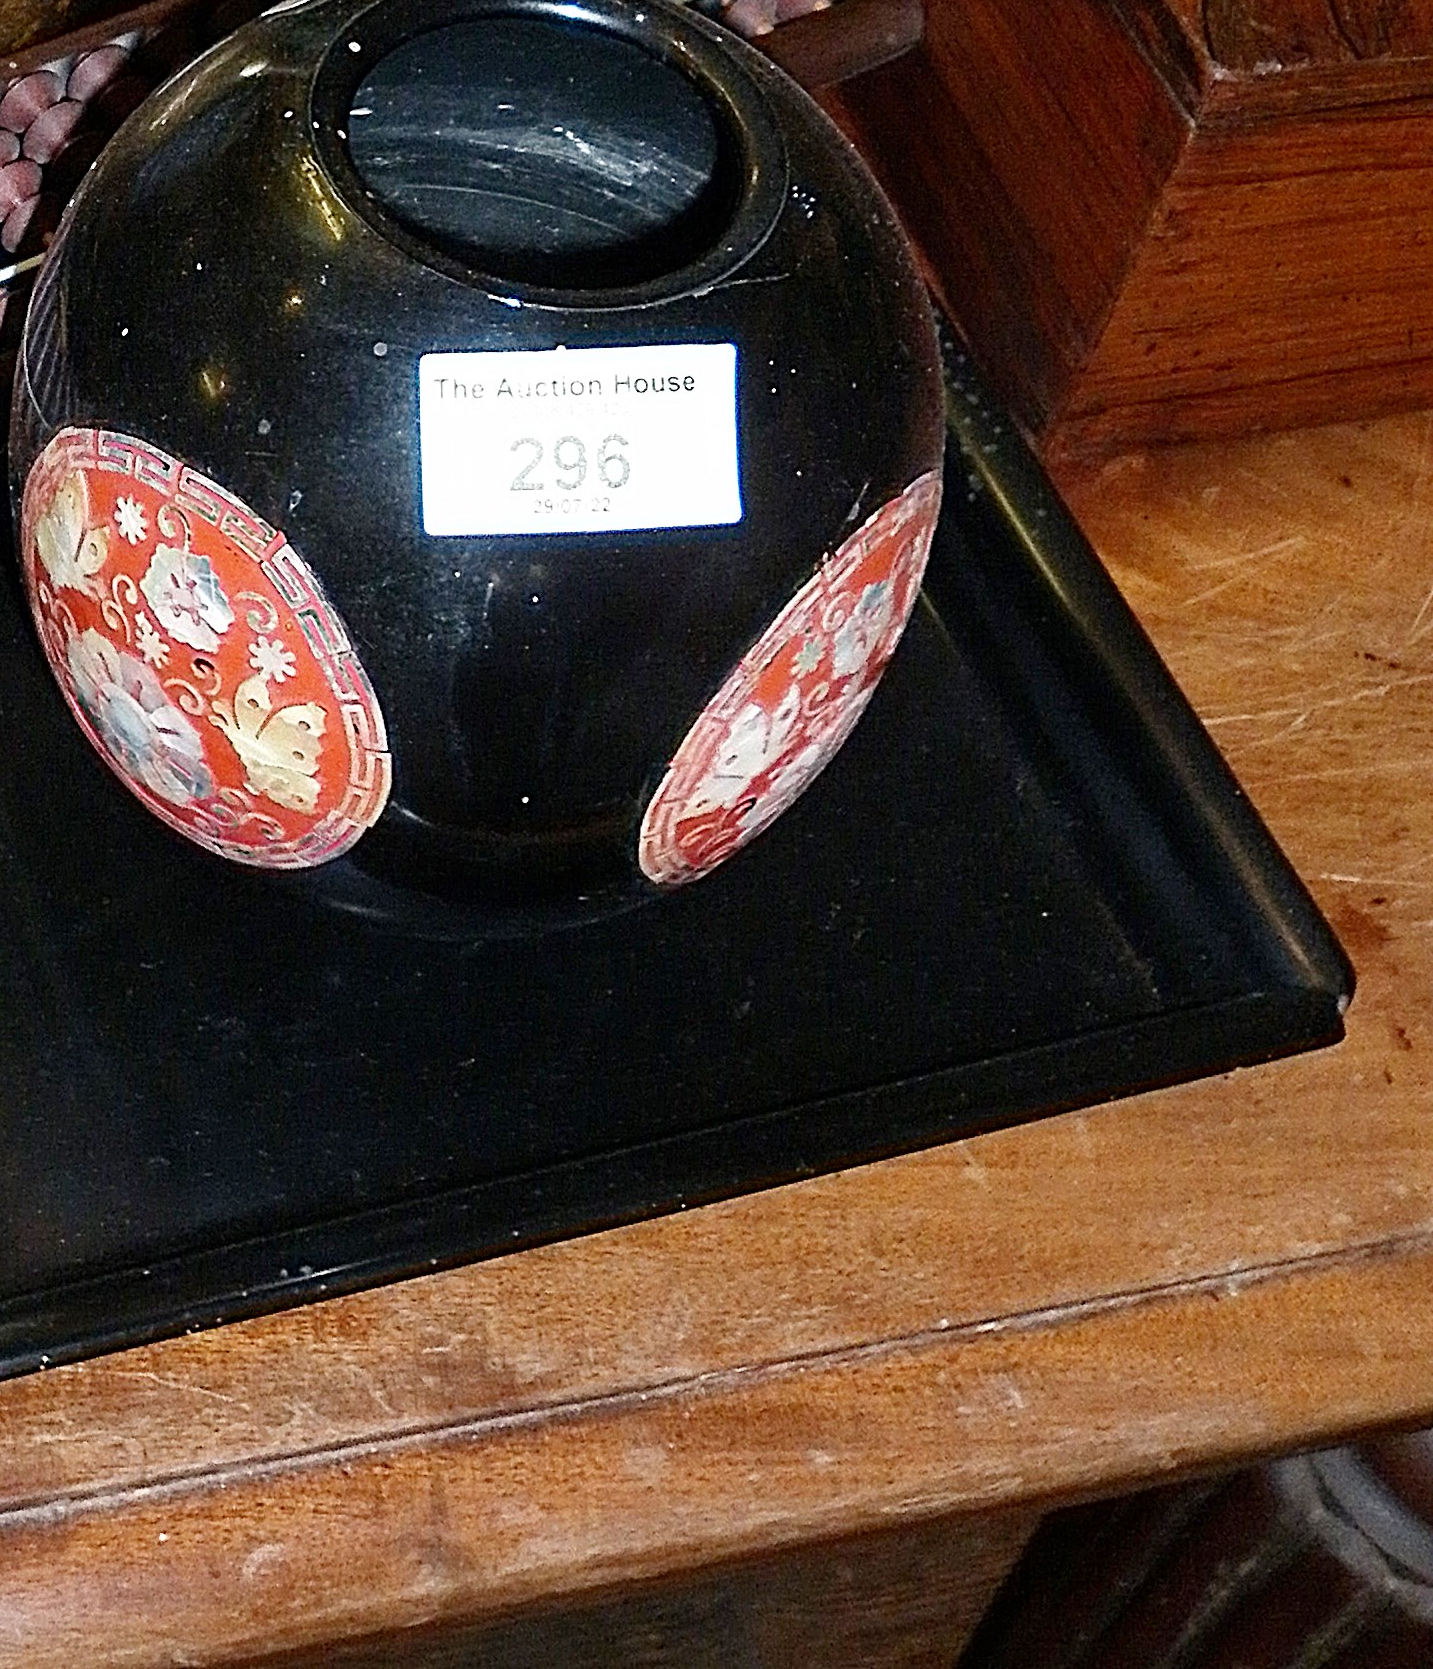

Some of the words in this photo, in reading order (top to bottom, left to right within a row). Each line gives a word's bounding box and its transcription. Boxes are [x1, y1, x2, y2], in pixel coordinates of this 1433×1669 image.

[433, 378, 485, 400] The
[496, 376, 603, 399] Auction
[613, 373, 696, 395] House
[509, 433, 631, 492] 296
